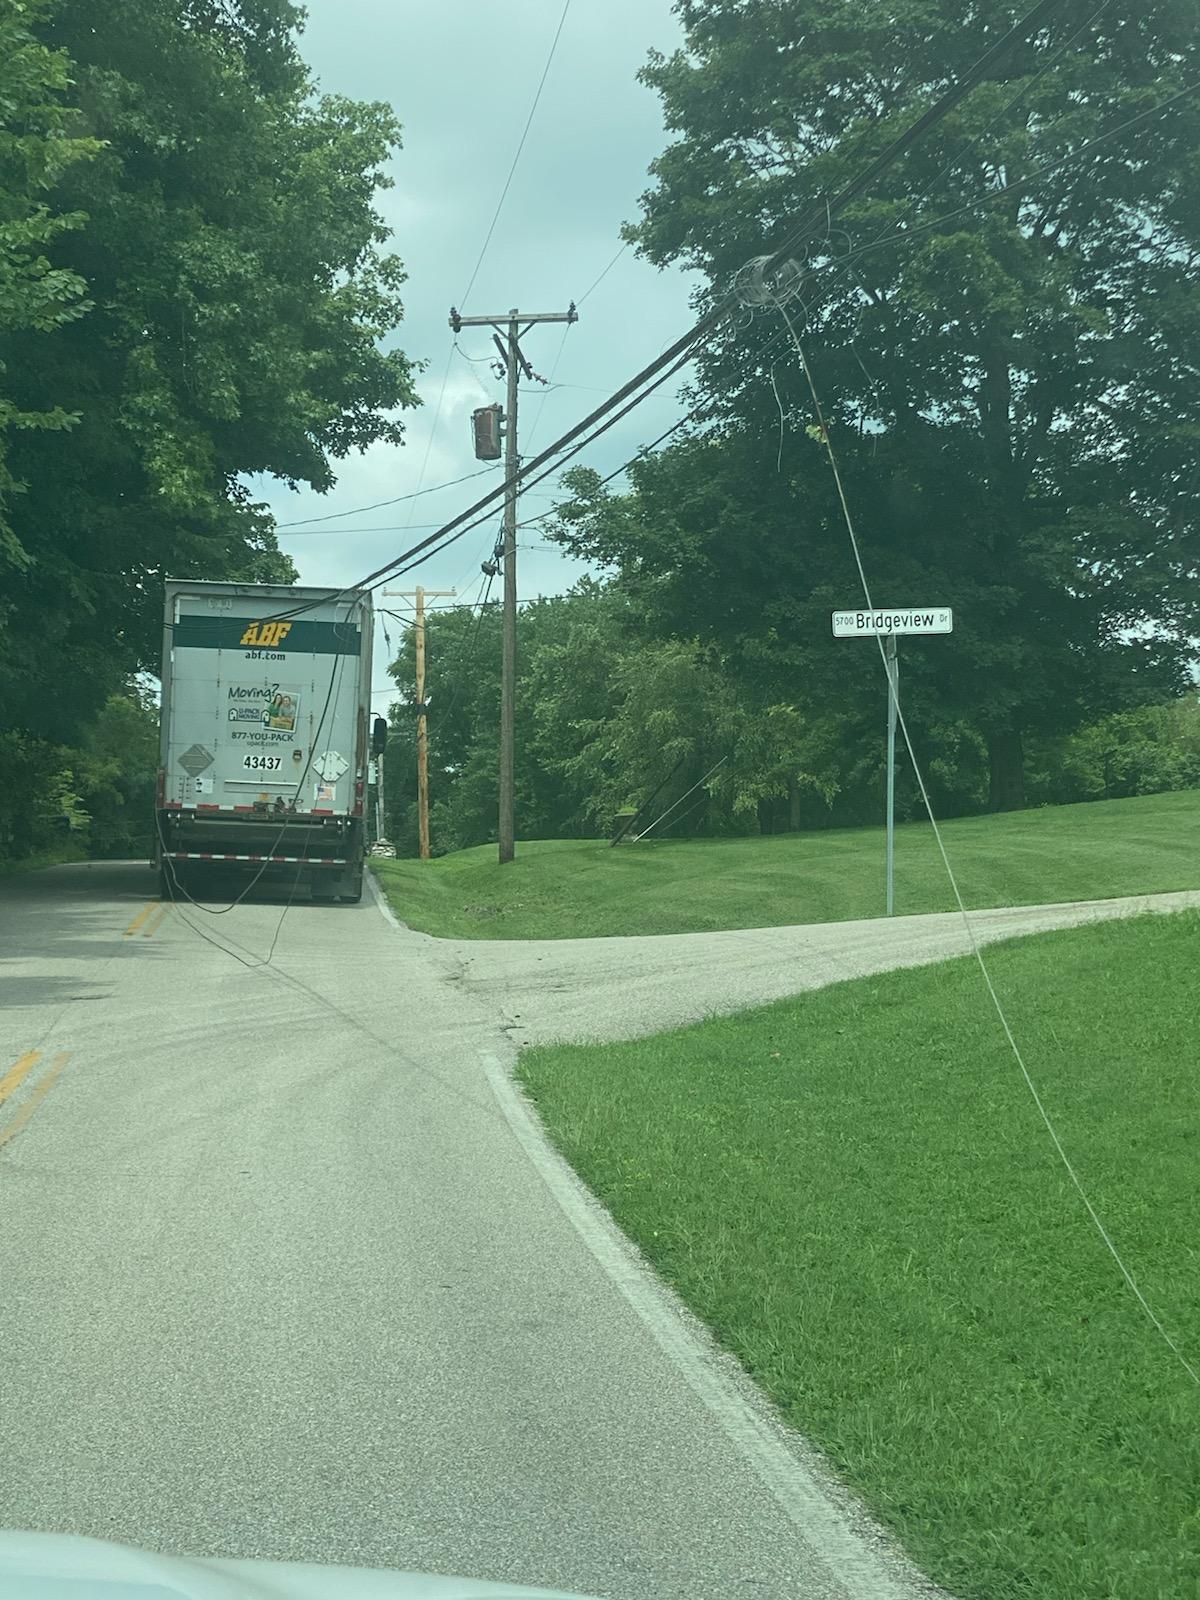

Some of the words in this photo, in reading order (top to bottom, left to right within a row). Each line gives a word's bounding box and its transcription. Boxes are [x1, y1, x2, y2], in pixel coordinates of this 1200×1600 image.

[835, 616, 854, 626] 5700
[856, 612, 934, 633] Bridgeview
[940, 614, 948, 623] Dr
[240, 622, 292, 647] ABF
[245, 650, 286, 661] abf.com
[228, 684, 279, 703] Moving?
[231, 731, 294, 742] 877-YOU-PACK
[244, 756, 281, 770] 43437
